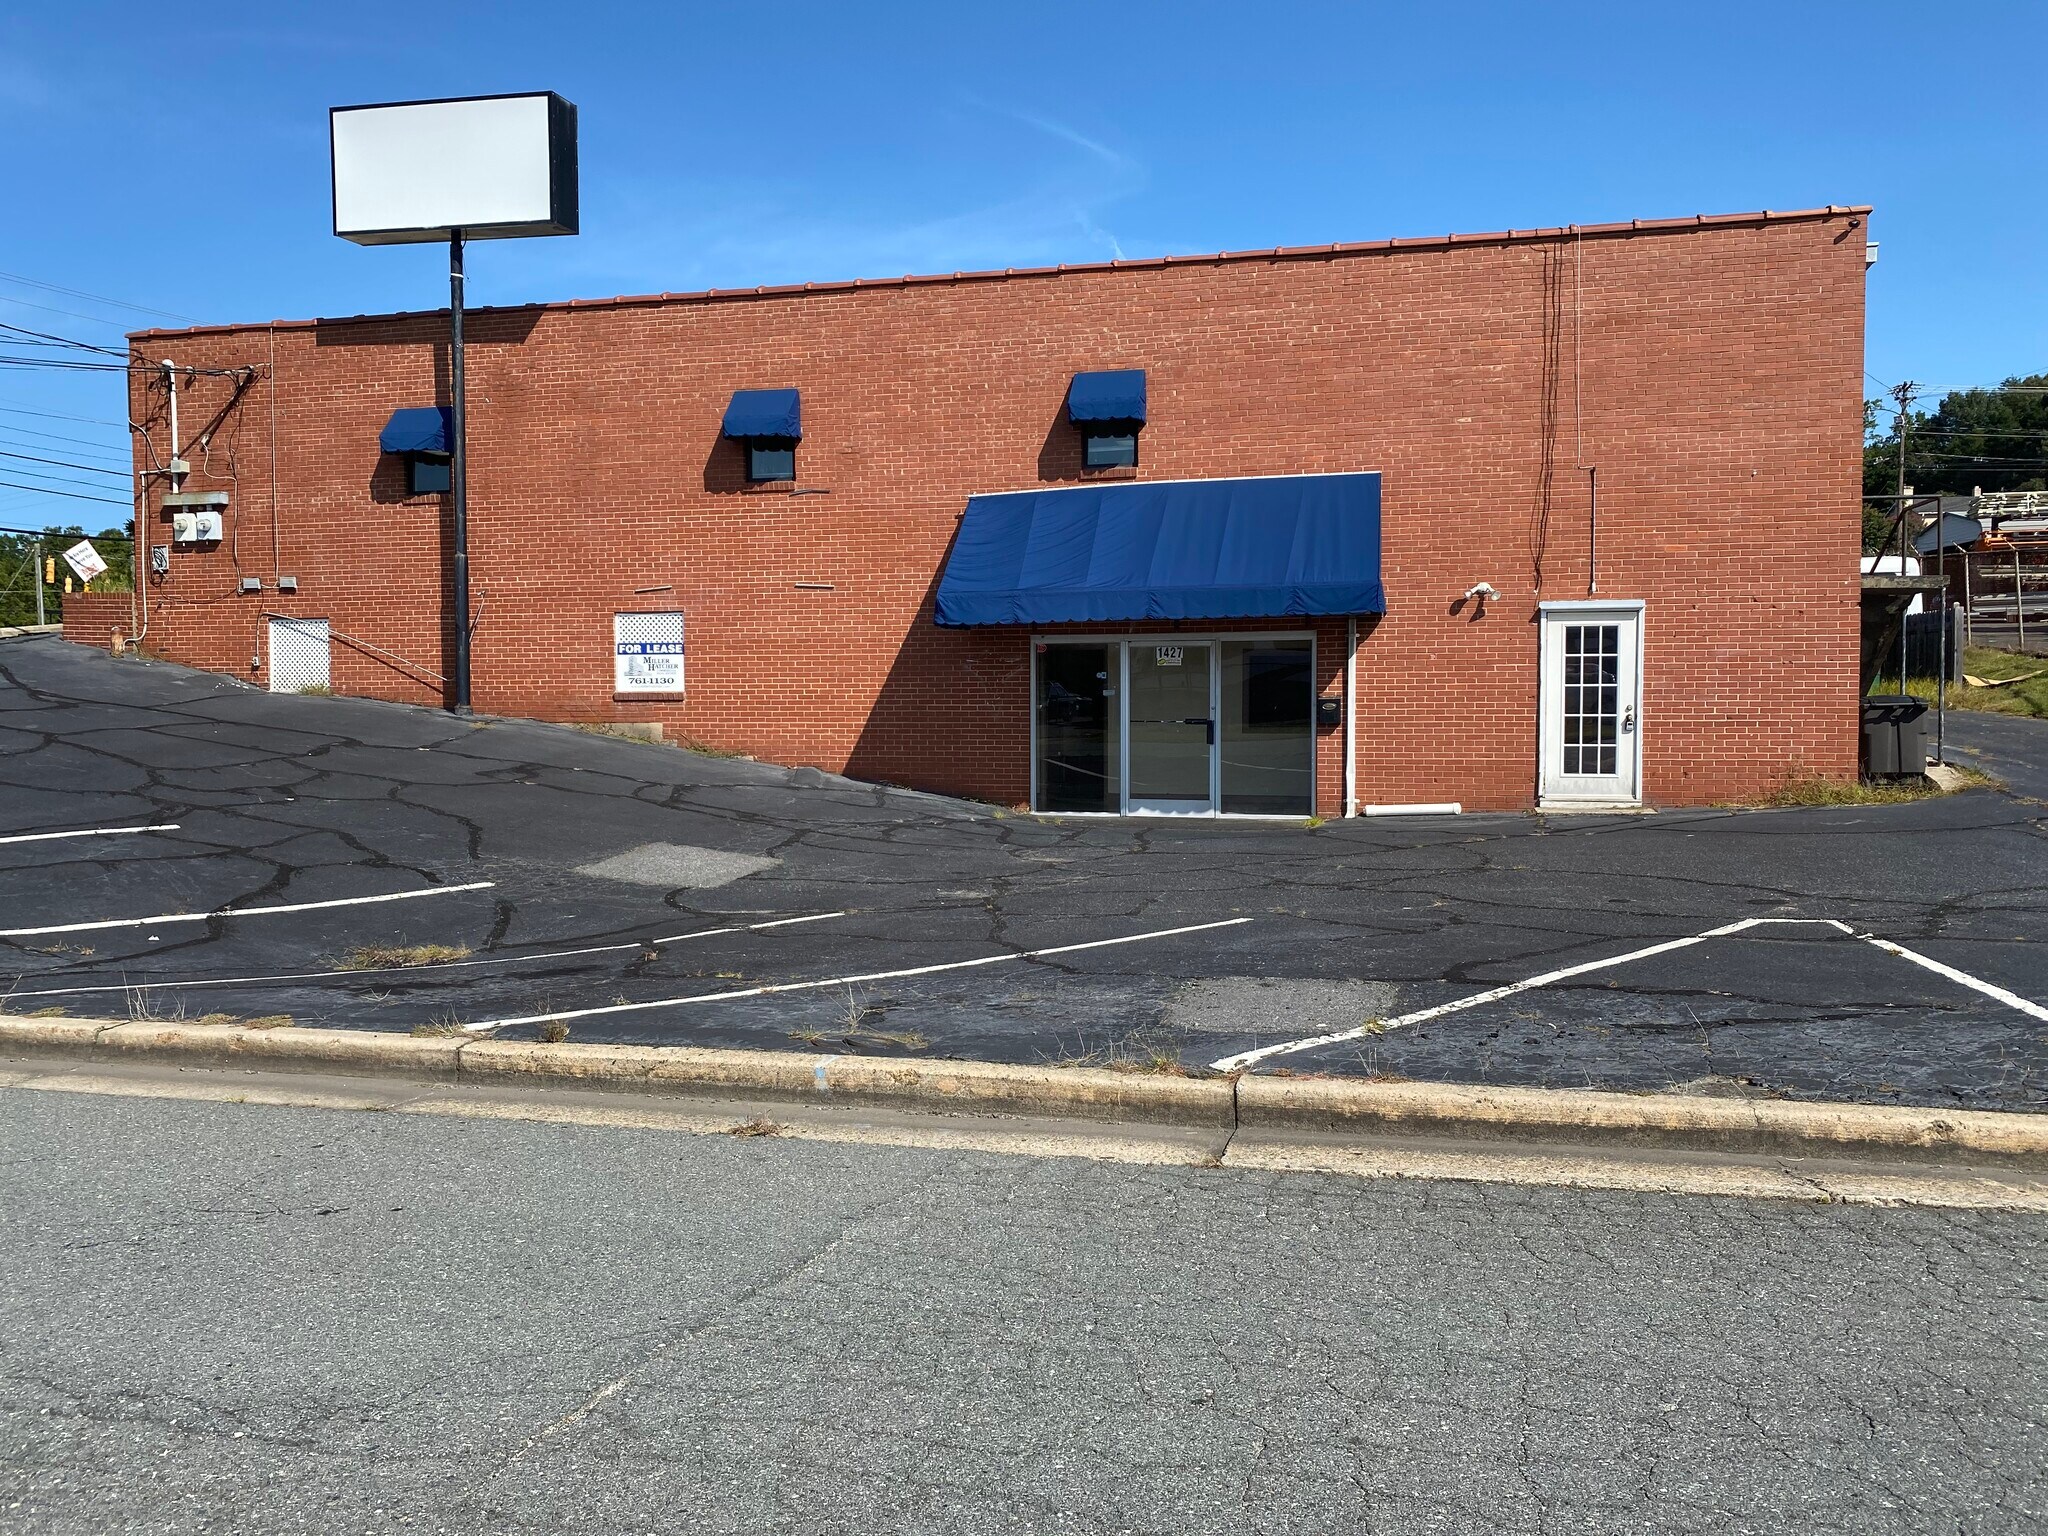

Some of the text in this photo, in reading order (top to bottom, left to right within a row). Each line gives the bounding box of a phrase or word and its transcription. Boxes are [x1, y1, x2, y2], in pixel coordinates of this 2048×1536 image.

[619, 644, 683, 653] FOR LEASE
[1158, 647, 1182, 658] 1427
